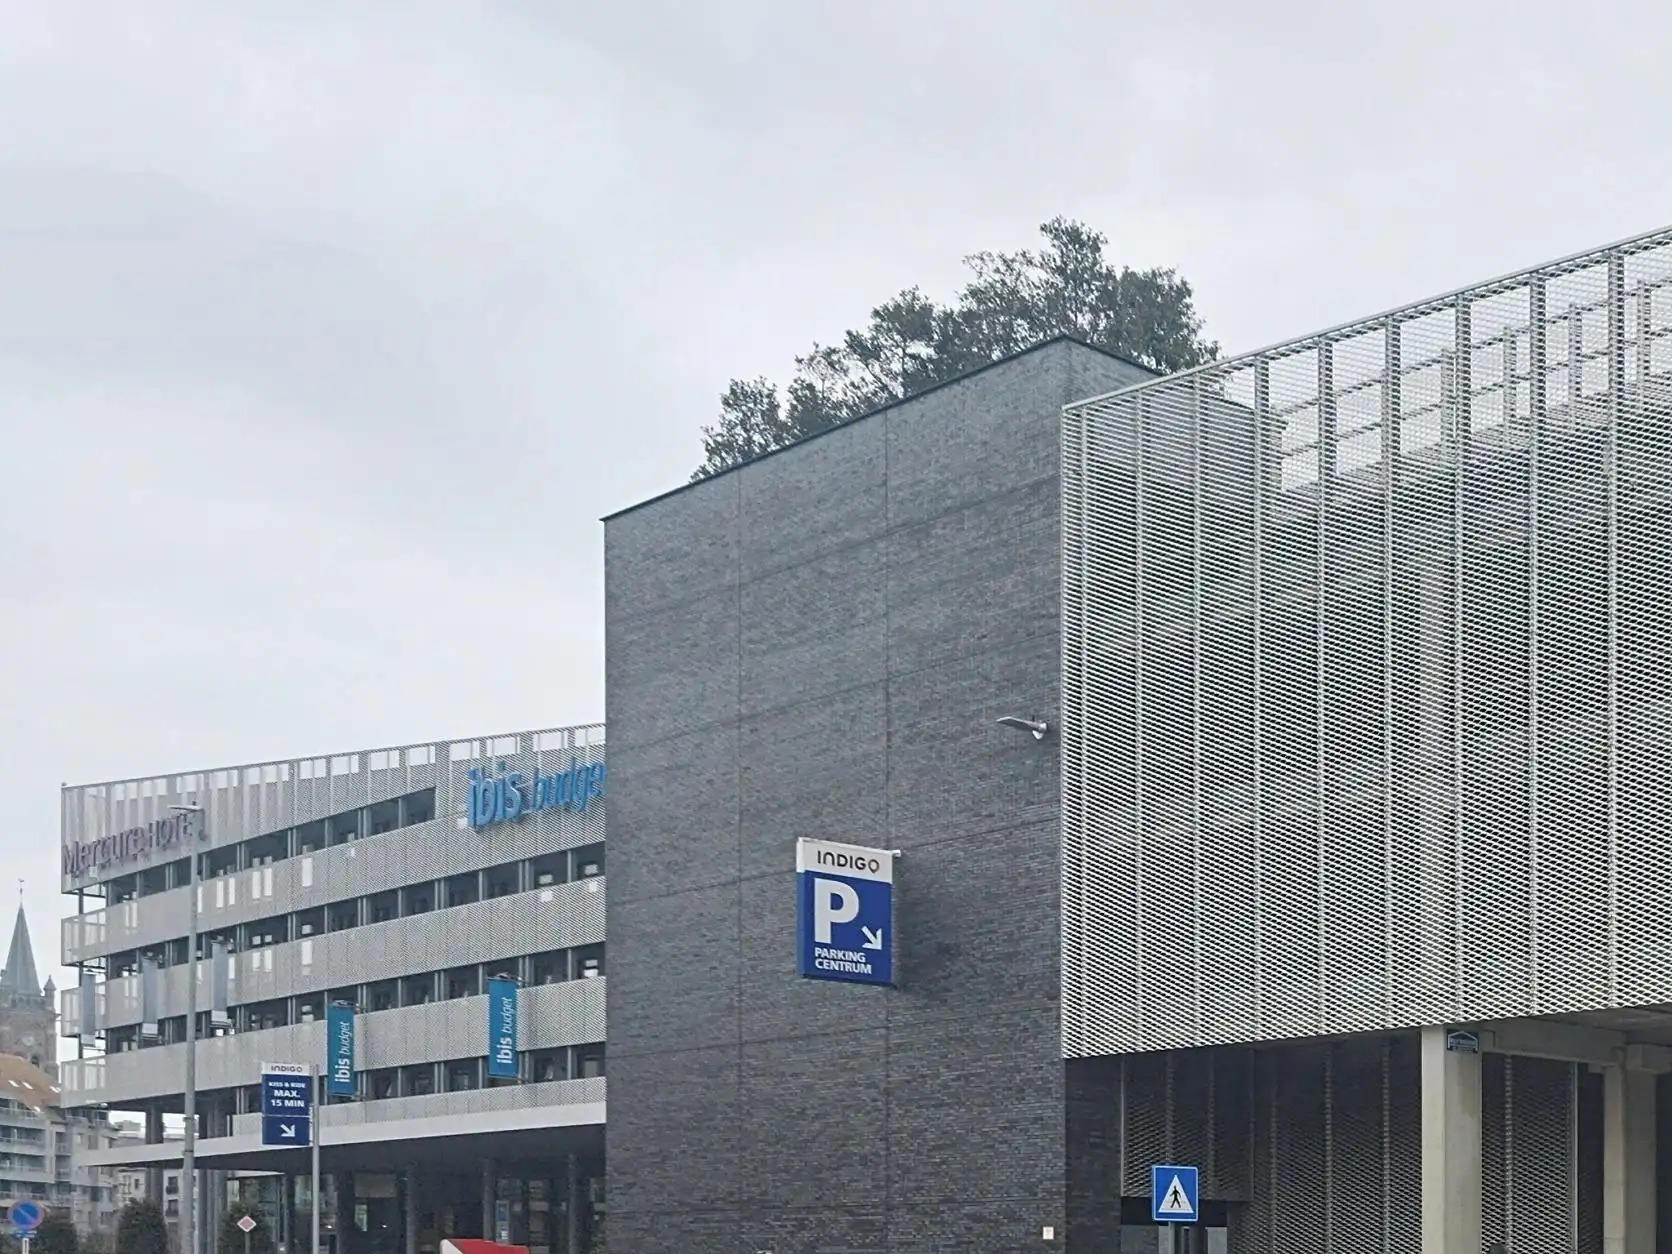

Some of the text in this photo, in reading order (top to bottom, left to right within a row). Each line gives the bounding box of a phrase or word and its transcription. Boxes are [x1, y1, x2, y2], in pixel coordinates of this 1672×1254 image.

[464, 759, 523, 833] ibis
[62, 811, 207, 876] Mercure HOTE
[816, 849, 880, 874] INDIGO
[814, 877, 860, 944] P
[814, 946, 866, 963] PARKING
[815, 958, 873, 975] CENTRUM
[333, 1020, 352, 1083] ibis budget
[495, 996, 515, 1064] ibis budget
[271, 1099, 305, 1107] 15 MIN
[273, 1089, 301, 1098] MAX.
